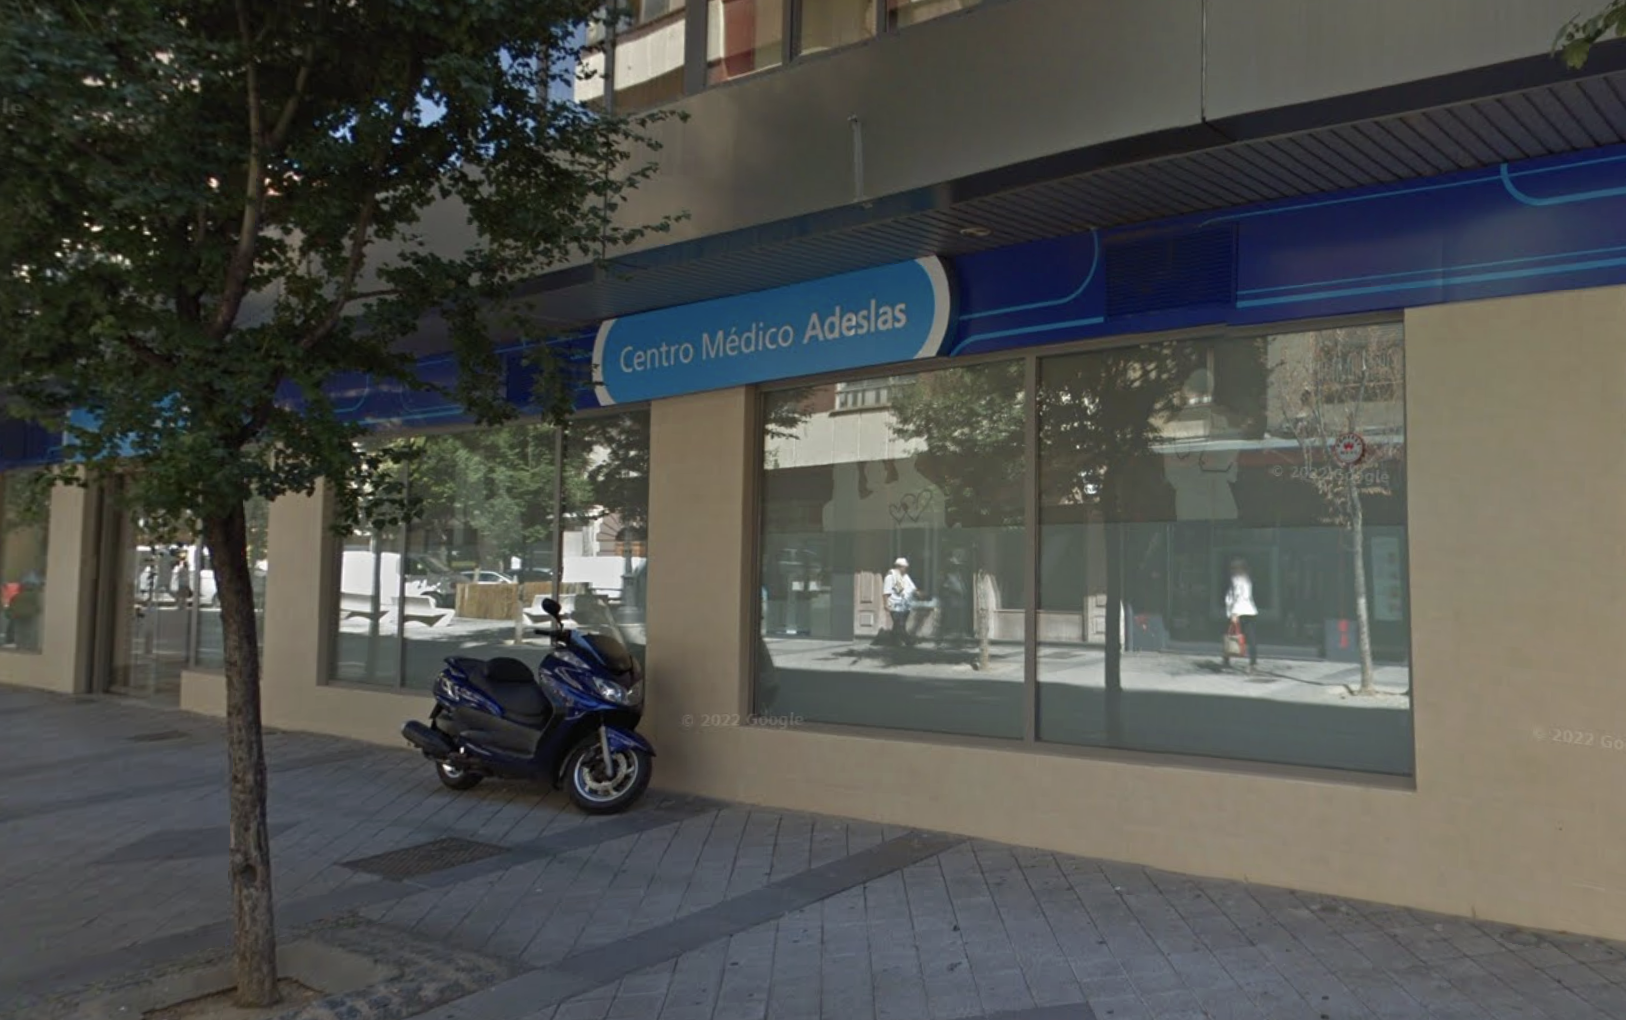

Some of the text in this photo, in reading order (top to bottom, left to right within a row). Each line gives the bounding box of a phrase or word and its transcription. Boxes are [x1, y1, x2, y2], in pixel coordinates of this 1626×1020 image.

[619, 298, 907, 373] Centro Médico Adeslas
